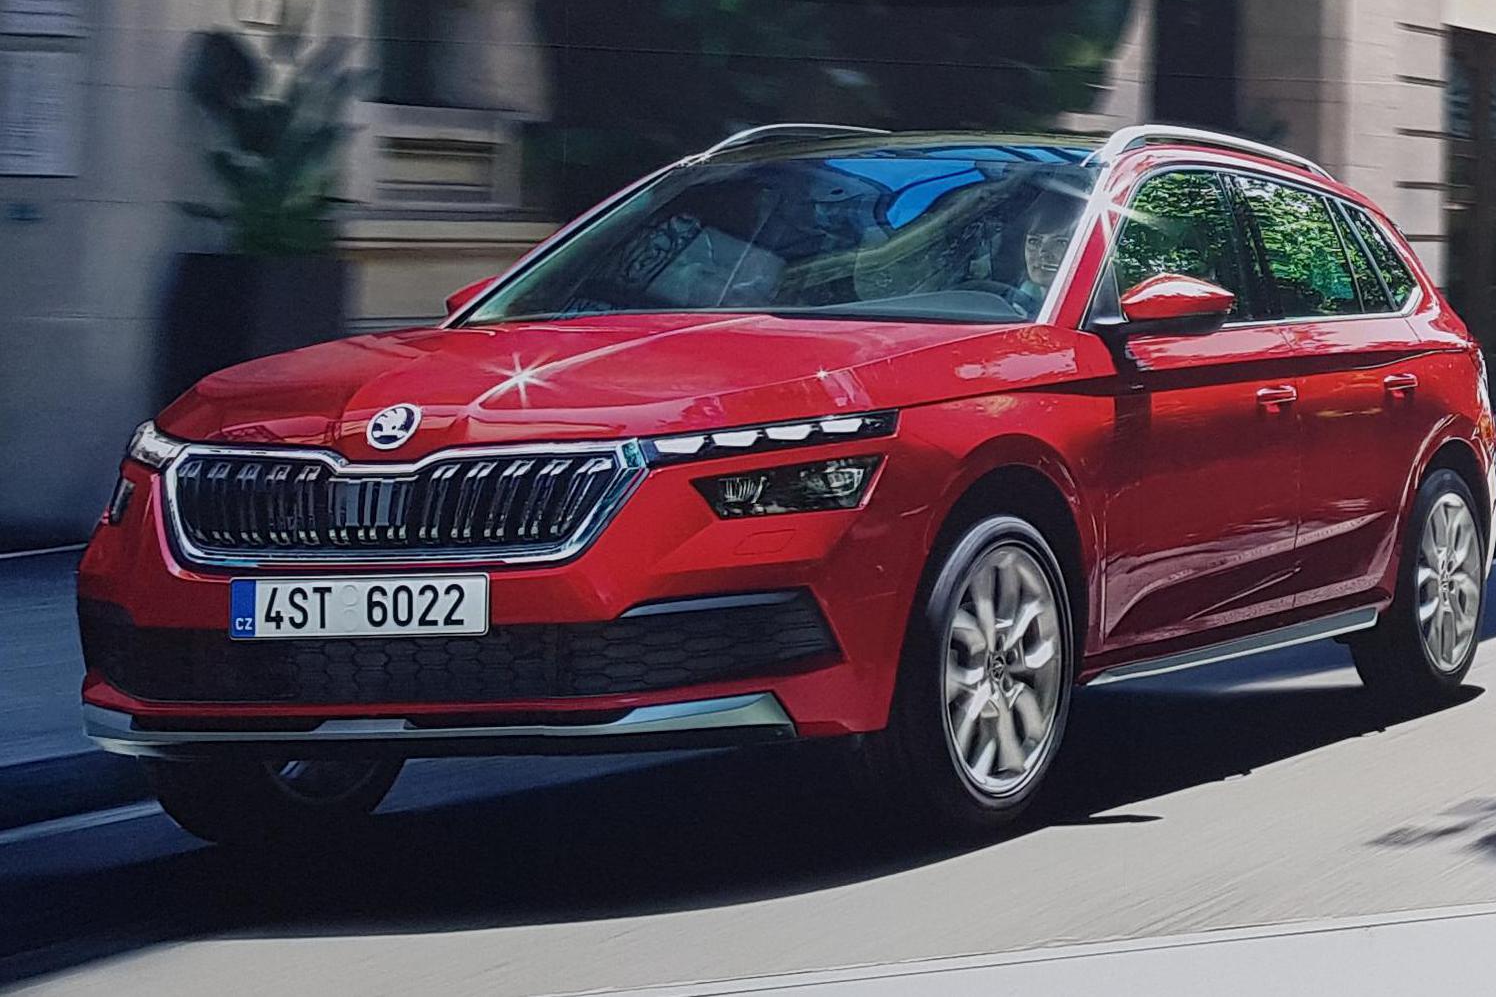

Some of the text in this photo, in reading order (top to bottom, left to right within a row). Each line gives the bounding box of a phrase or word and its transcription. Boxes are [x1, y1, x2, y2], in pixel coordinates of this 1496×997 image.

[264, 583, 465, 630] 4ST 6022
[234, 617, 253, 631] CZ
